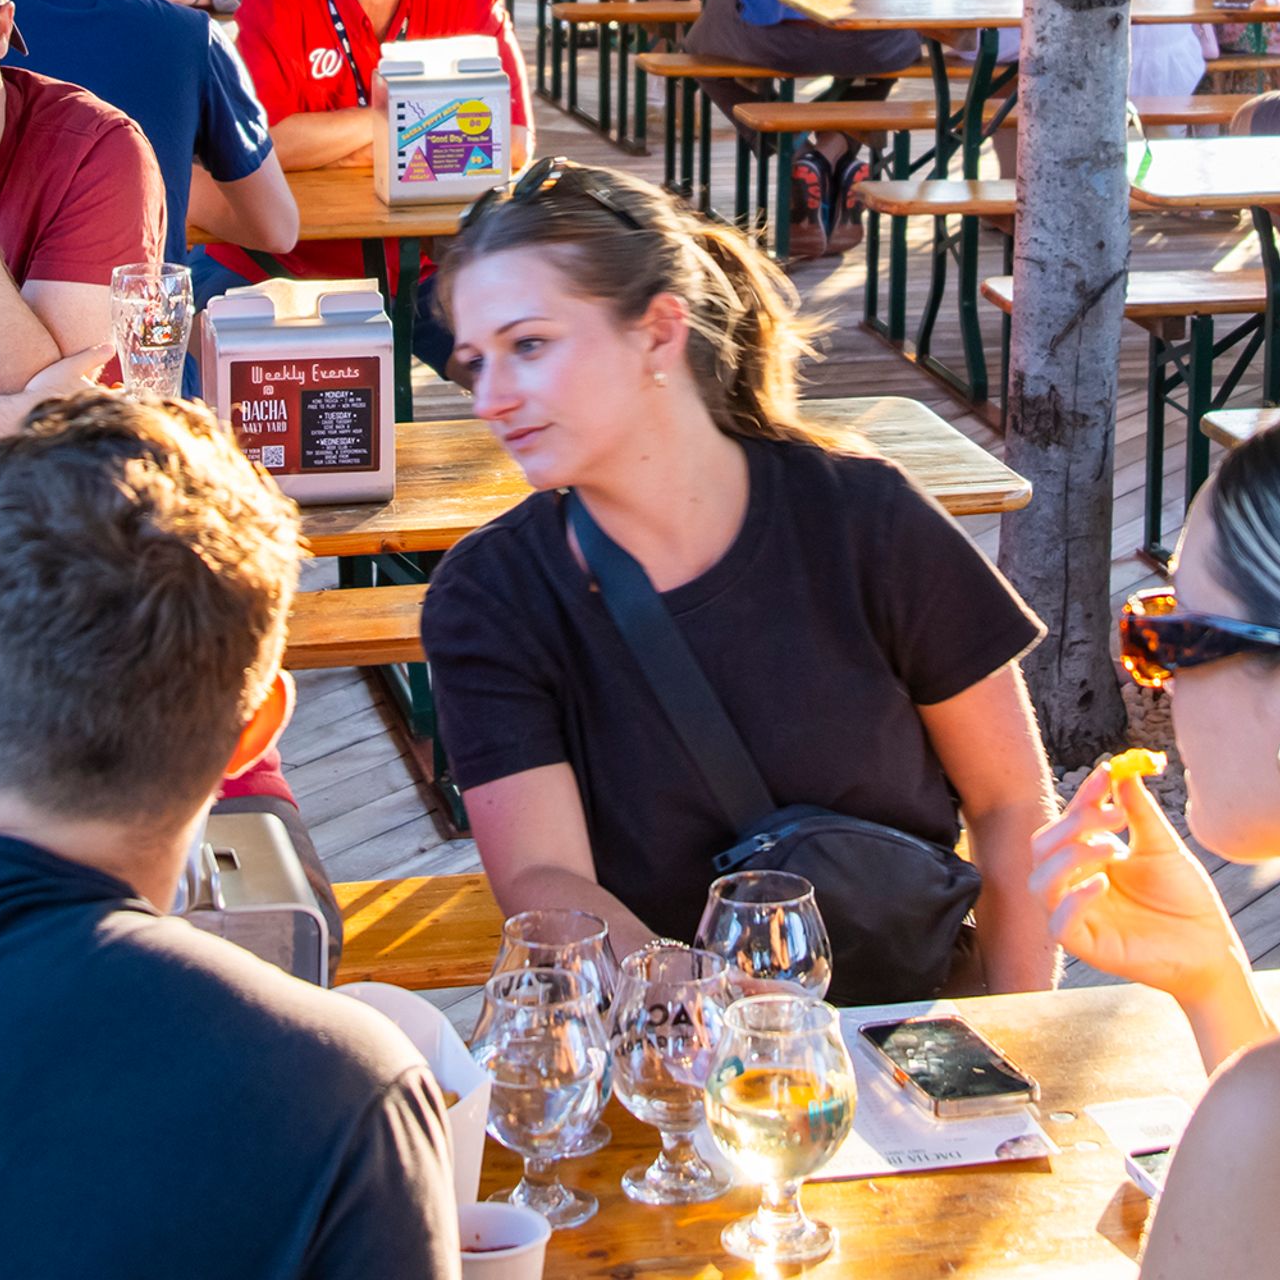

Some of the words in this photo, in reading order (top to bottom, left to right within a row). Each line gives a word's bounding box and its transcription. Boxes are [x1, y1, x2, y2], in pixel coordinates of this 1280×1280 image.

[308, 47, 344, 80] W
[251, 365, 305, 385] Weekly
[312, 364, 360, 382] Events
[241, 399, 288, 422] DACHA
[324, 412, 352, 420] TUESDAY
[242, 422, 265, 434] NAVY
[267, 421, 287, 433] YARD
[320, 437, 356, 445] WEDNESDAY
